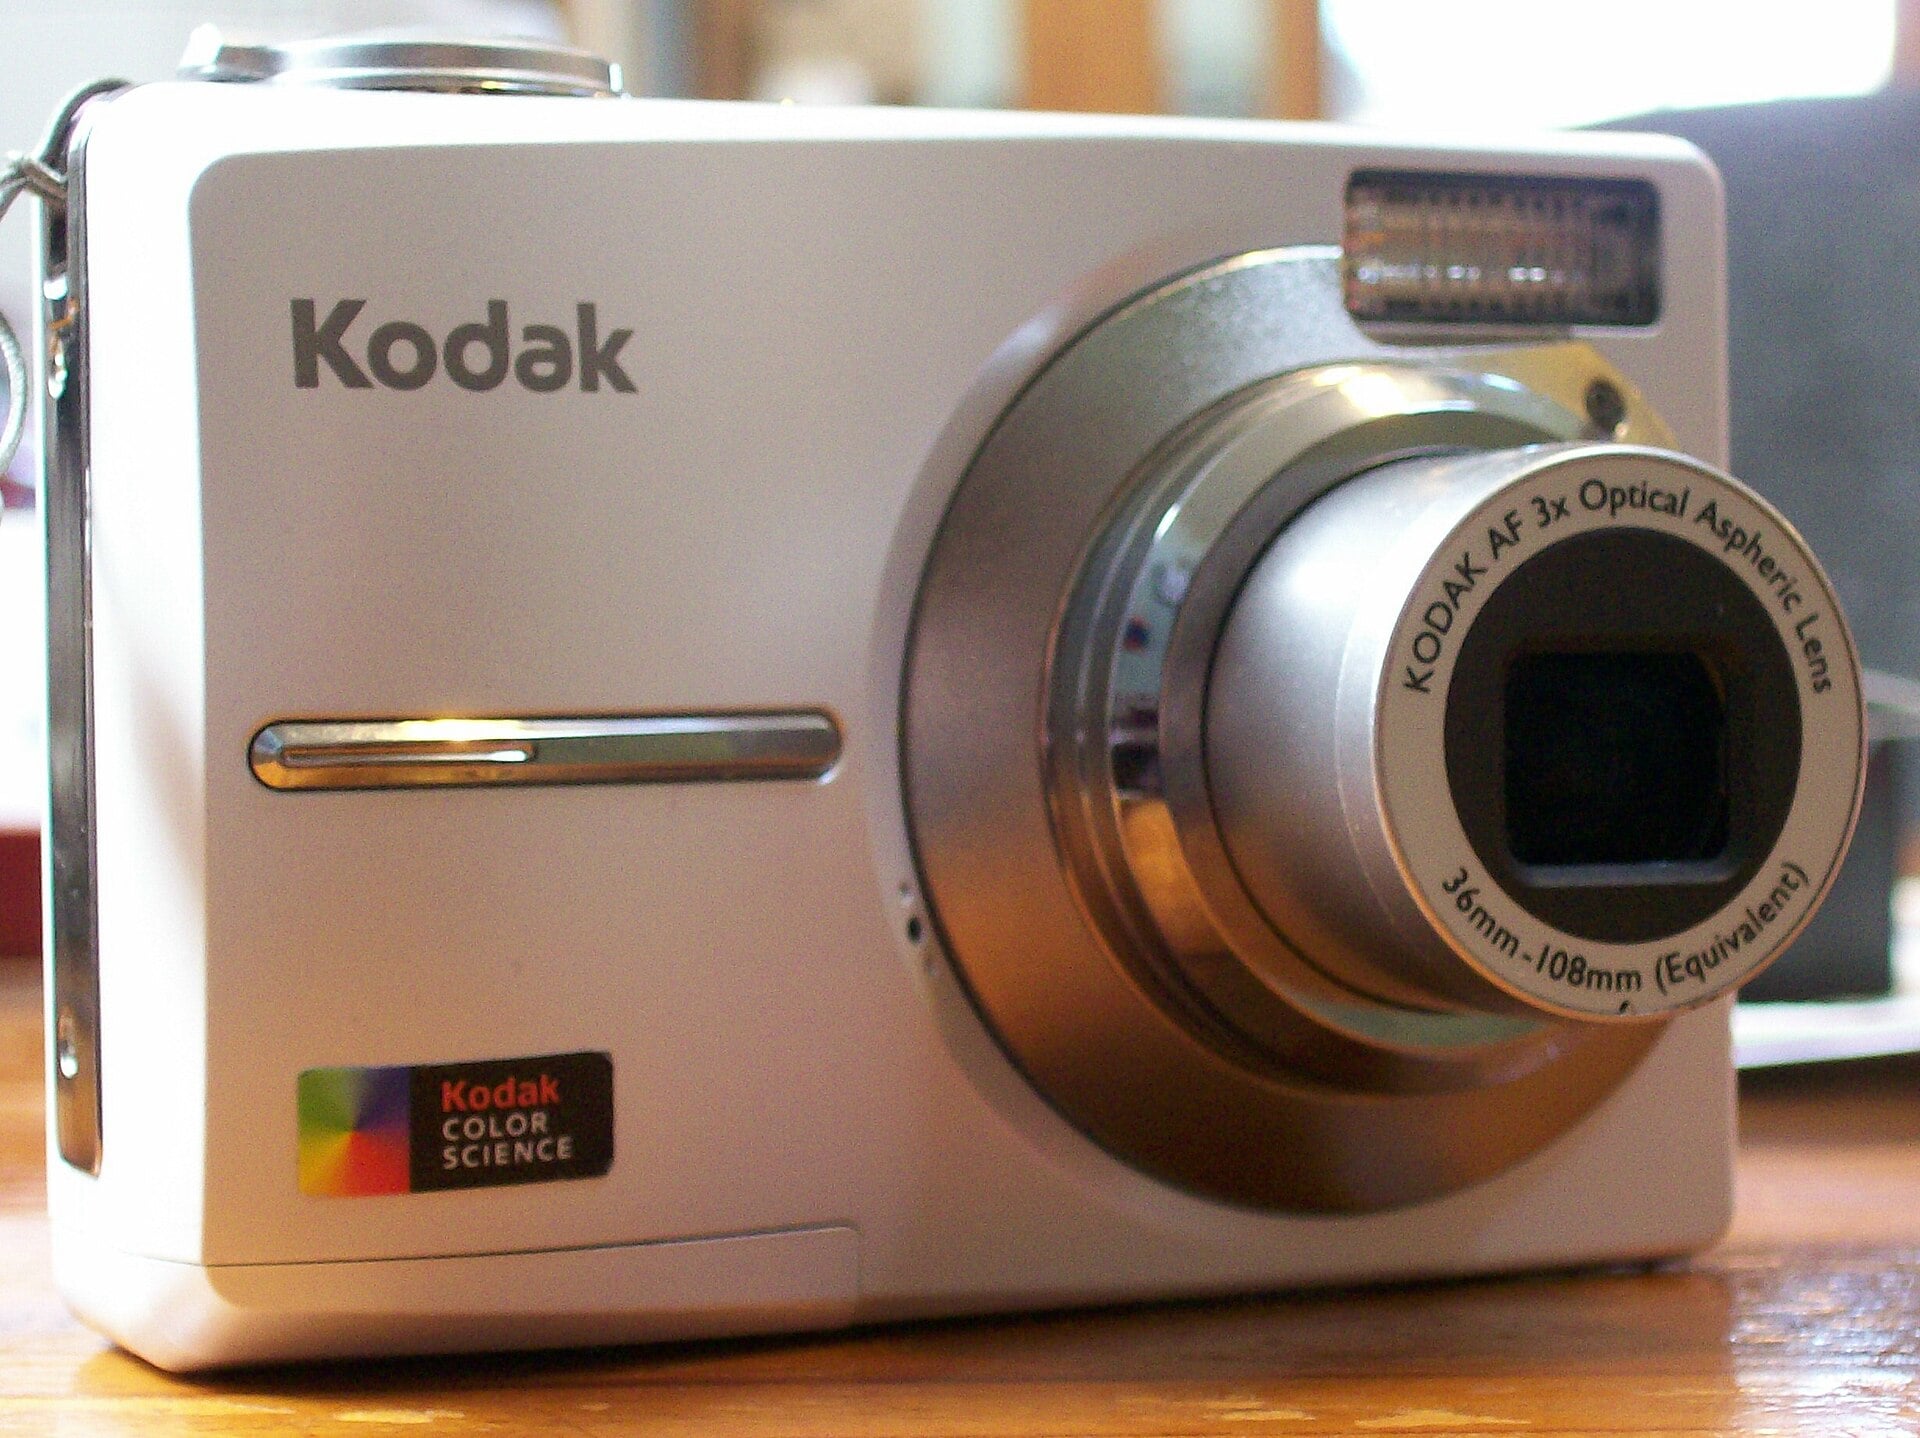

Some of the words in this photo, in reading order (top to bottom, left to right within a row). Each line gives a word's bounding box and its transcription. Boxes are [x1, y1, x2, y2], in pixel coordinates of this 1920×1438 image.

[290, 297, 639, 394] Kodak
[1403, 552, 1488, 694] KODAK
[1487, 509, 1524, 562] AF
[1531, 495, 1571, 529] 3x
[1579, 477, 1691, 518] Optical
[1698, 500, 1804, 614] Aspheric
[1796, 613, 1833, 695] Lens
[1655, 861, 1811, 997] (Equivalent)
[440, 1073, 561, 1113] Kodak
[441, 1110, 549, 1142] COLOR
[441, 1134, 575, 1171] SCIENCE
